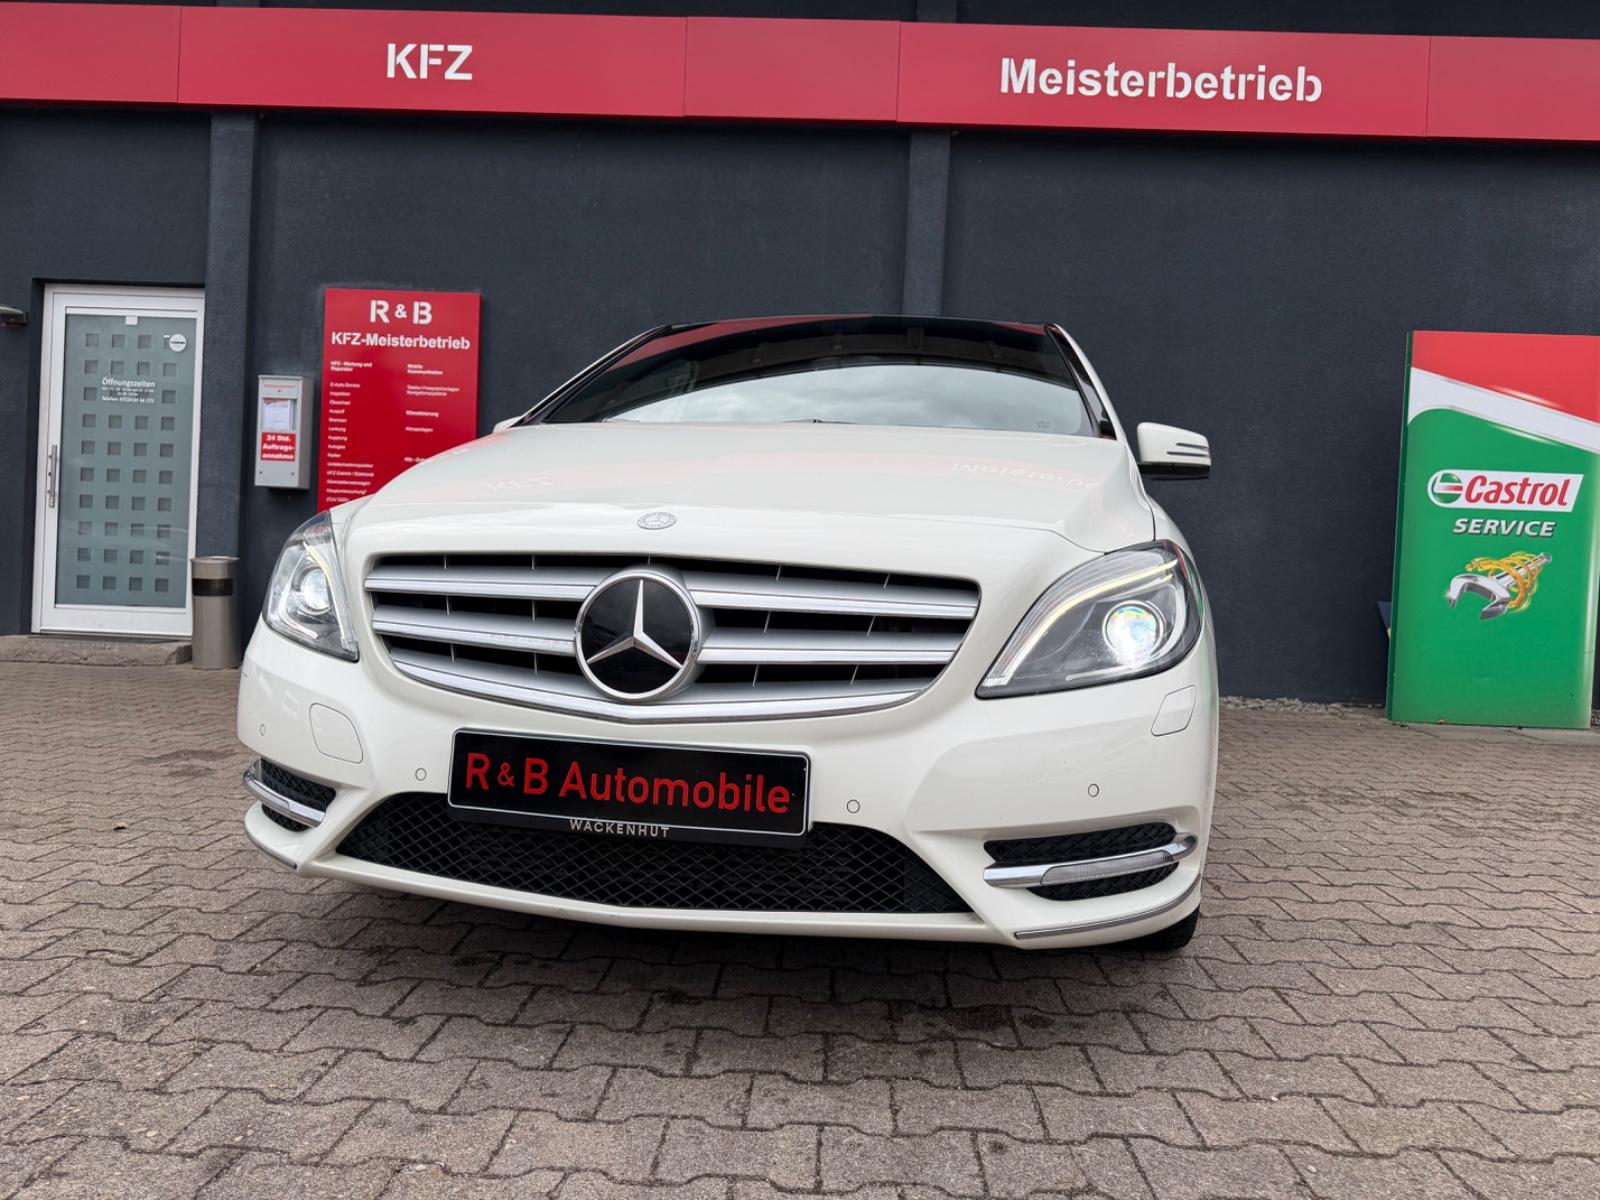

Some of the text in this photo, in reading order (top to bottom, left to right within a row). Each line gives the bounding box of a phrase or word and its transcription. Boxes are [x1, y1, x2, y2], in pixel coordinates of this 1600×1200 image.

[386, 43, 473, 80] KFZ
[1000, 57, 1323, 103] Meisterbetrieb
[369, 299, 433, 325] R & B
[331, 331, 471, 350] KFZ-Meisterbetrieb
[101, 377, 156, 389] Öffnungszeiten
[1465, 474, 1571, 507] Castrol
[1453, 517, 1556, 538] SERVICE
[465, 752, 791, 814] R & B Automobile
[569, 818, 671, 839] WACKENHUT
